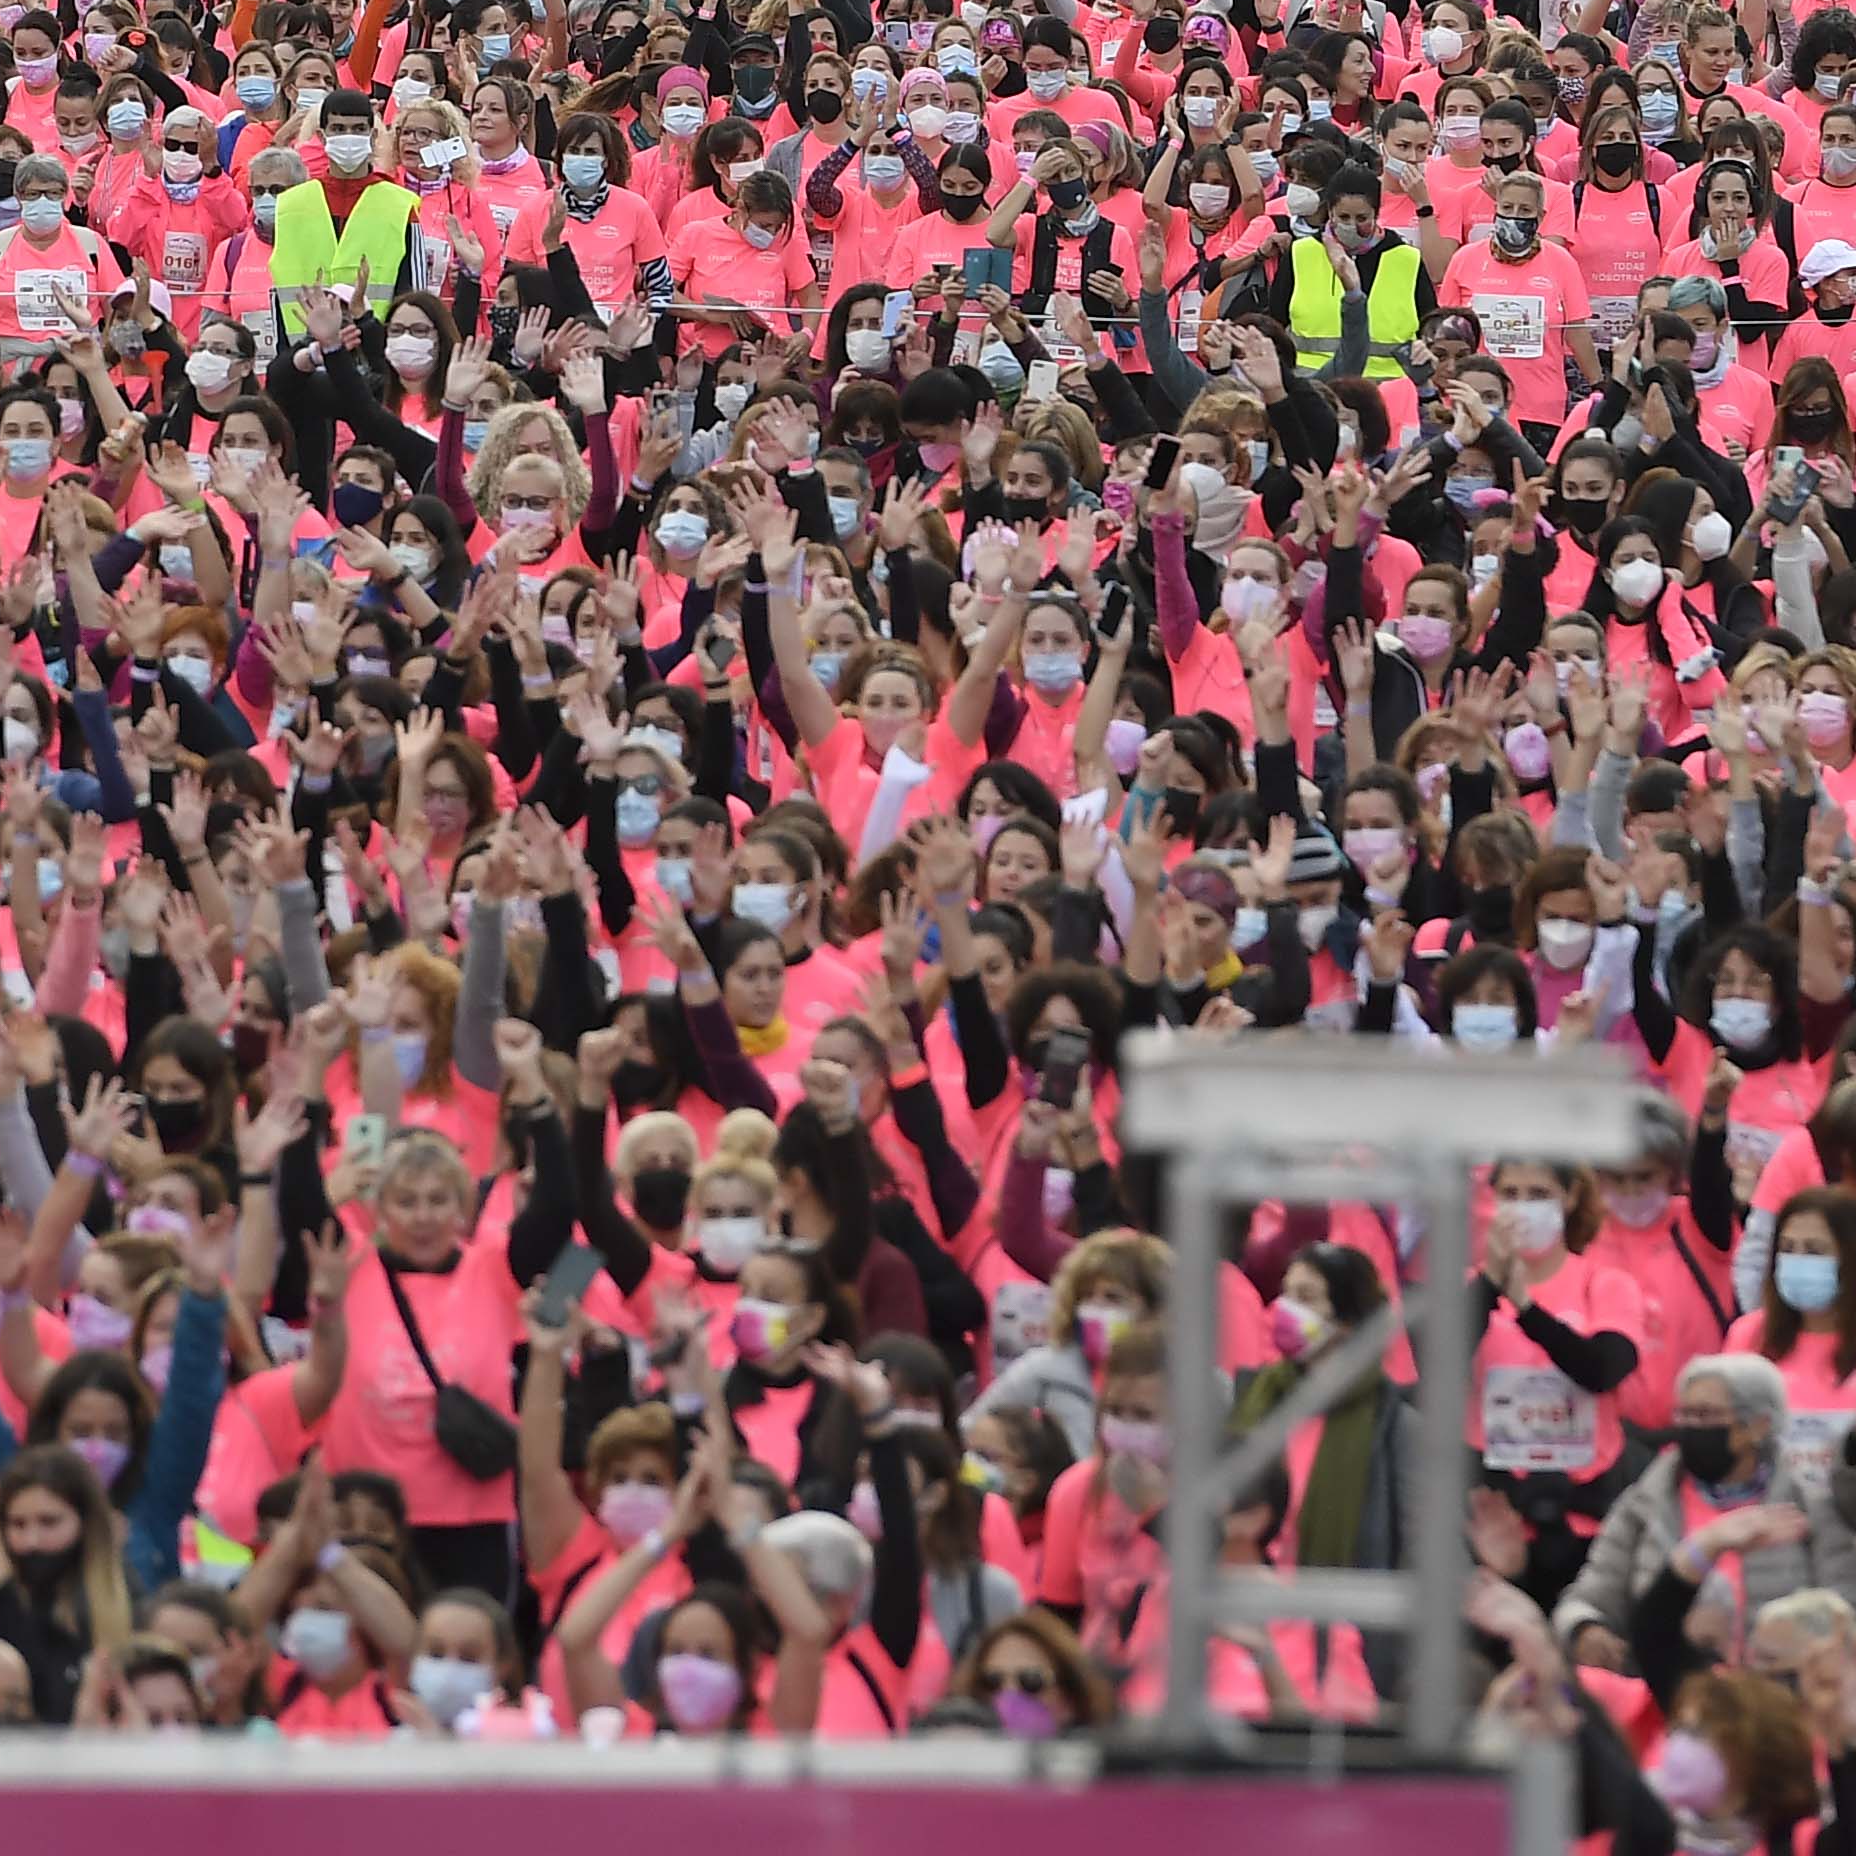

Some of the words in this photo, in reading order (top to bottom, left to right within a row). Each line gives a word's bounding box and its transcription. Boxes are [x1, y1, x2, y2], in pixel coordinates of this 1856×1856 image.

[1625, 251, 1647, 259] POR
[164, 256, 193, 271] 016
[1613, 263, 1647, 272] TODAS
